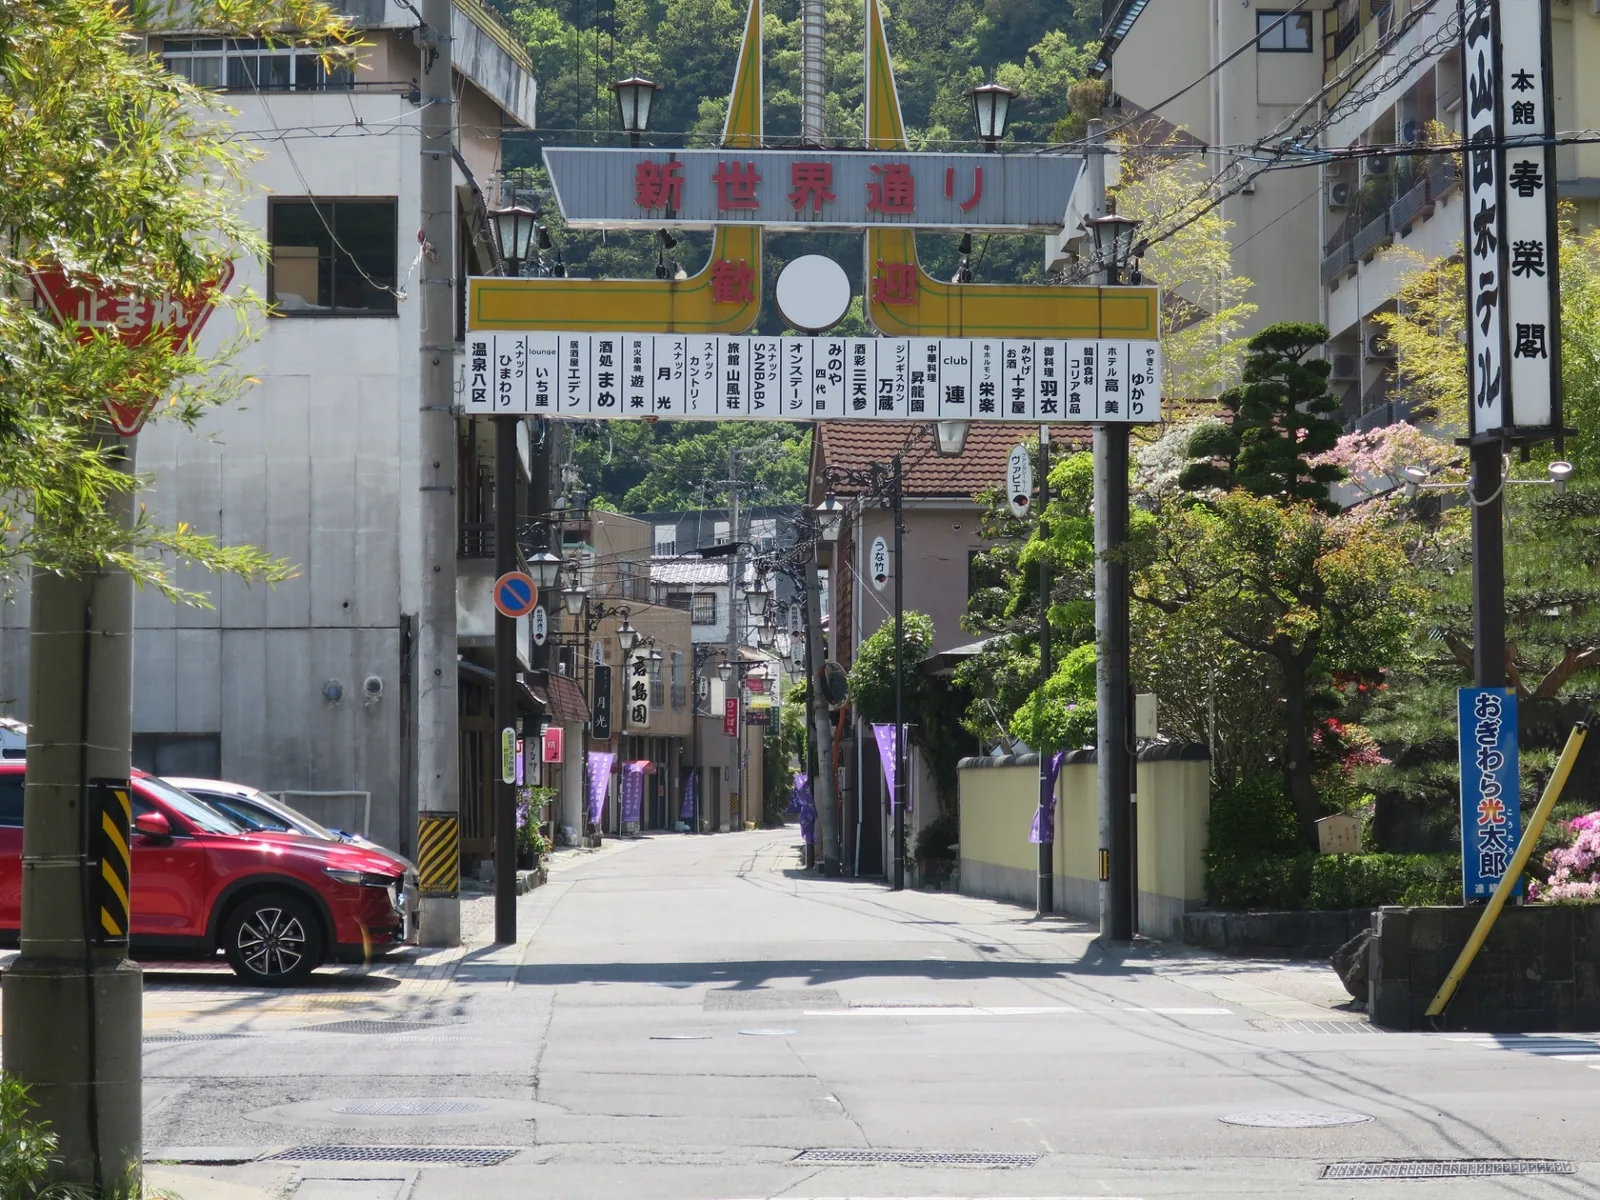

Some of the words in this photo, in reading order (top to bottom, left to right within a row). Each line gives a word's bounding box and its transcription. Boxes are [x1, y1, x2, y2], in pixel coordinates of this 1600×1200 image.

[1510, 68, 1536, 126] 本館
[634, 159, 984, 214] 新世界通り
[1508, 159, 1549, 360] 春榮閣
[78, 290, 189, 330] 止まれ
[515, 340, 526, 380] スナック
[528, 348, 557, 356] lounge
[673, 342, 683, 380] スナック
[704, 342, 714, 380] スナック
[767, 343, 778, 381] スナック
[827, 343, 843, 388] みのや
[926, 344, 937, 383] 中華料理
[943, 355, 968, 366] club
[1006, 348, 1017, 369] お酒
[1021, 345, 1032, 376] みやげ
[1083, 346, 1094, 386] 韓国食材
[1145, 348, 1155, 385] やきとり
[471, 342, 488, 403] 温泉八区
[498, 354, 513, 407] ひまわり
[535, 367, 549, 407] いち里
[656, 367, 672, 410] 月光
[753, 343, 766, 410] SANBABA
[789, 342, 803, 410] オンステージ
[815, 368, 827, 410] 四代目
[895, 344, 905, 402] ジンギスカン
[1069, 359, 1081, 415] コリア食品
[878, 378, 894, 412] 万蔵
[945, 385, 966, 404] 連
[1011, 374, 1026, 415] 十字屋
[1131, 373, 1145, 415] ゆかり
[874, 541, 886, 573] うな竹
[595, 696, 608, 728] 月光
[1474, 692, 1509, 880] おぎわら光太郎
[1507, 808, 1515, 856] こうたろ
